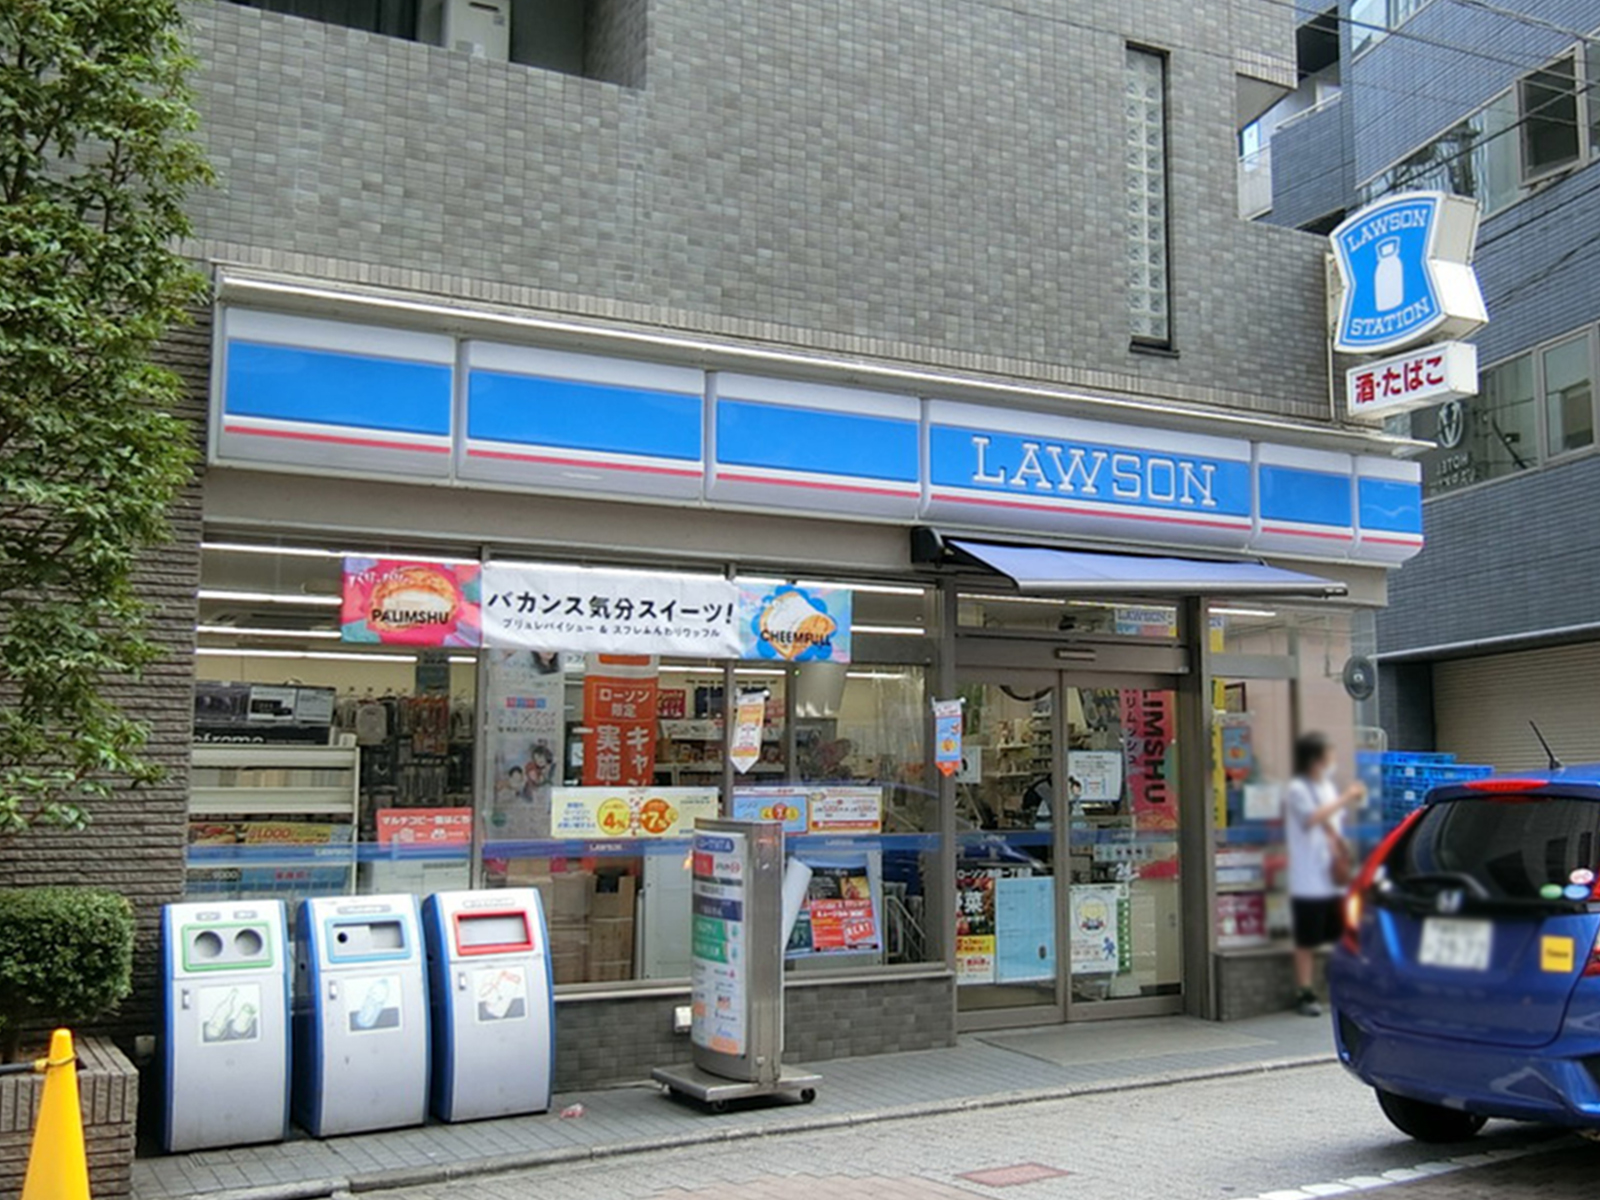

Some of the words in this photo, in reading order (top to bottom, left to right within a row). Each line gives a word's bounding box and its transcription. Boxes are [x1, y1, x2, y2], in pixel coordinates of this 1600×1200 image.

[1347, 209, 1428, 253] LAWSON
[1350, 296, 1431, 336] STATION
[972, 436, 1217, 507] LAWSON
[371, 609, 450, 625] PALIMSHU
[599, 688, 651, 703] ローソン
[596, 724, 621, 785] 実施
